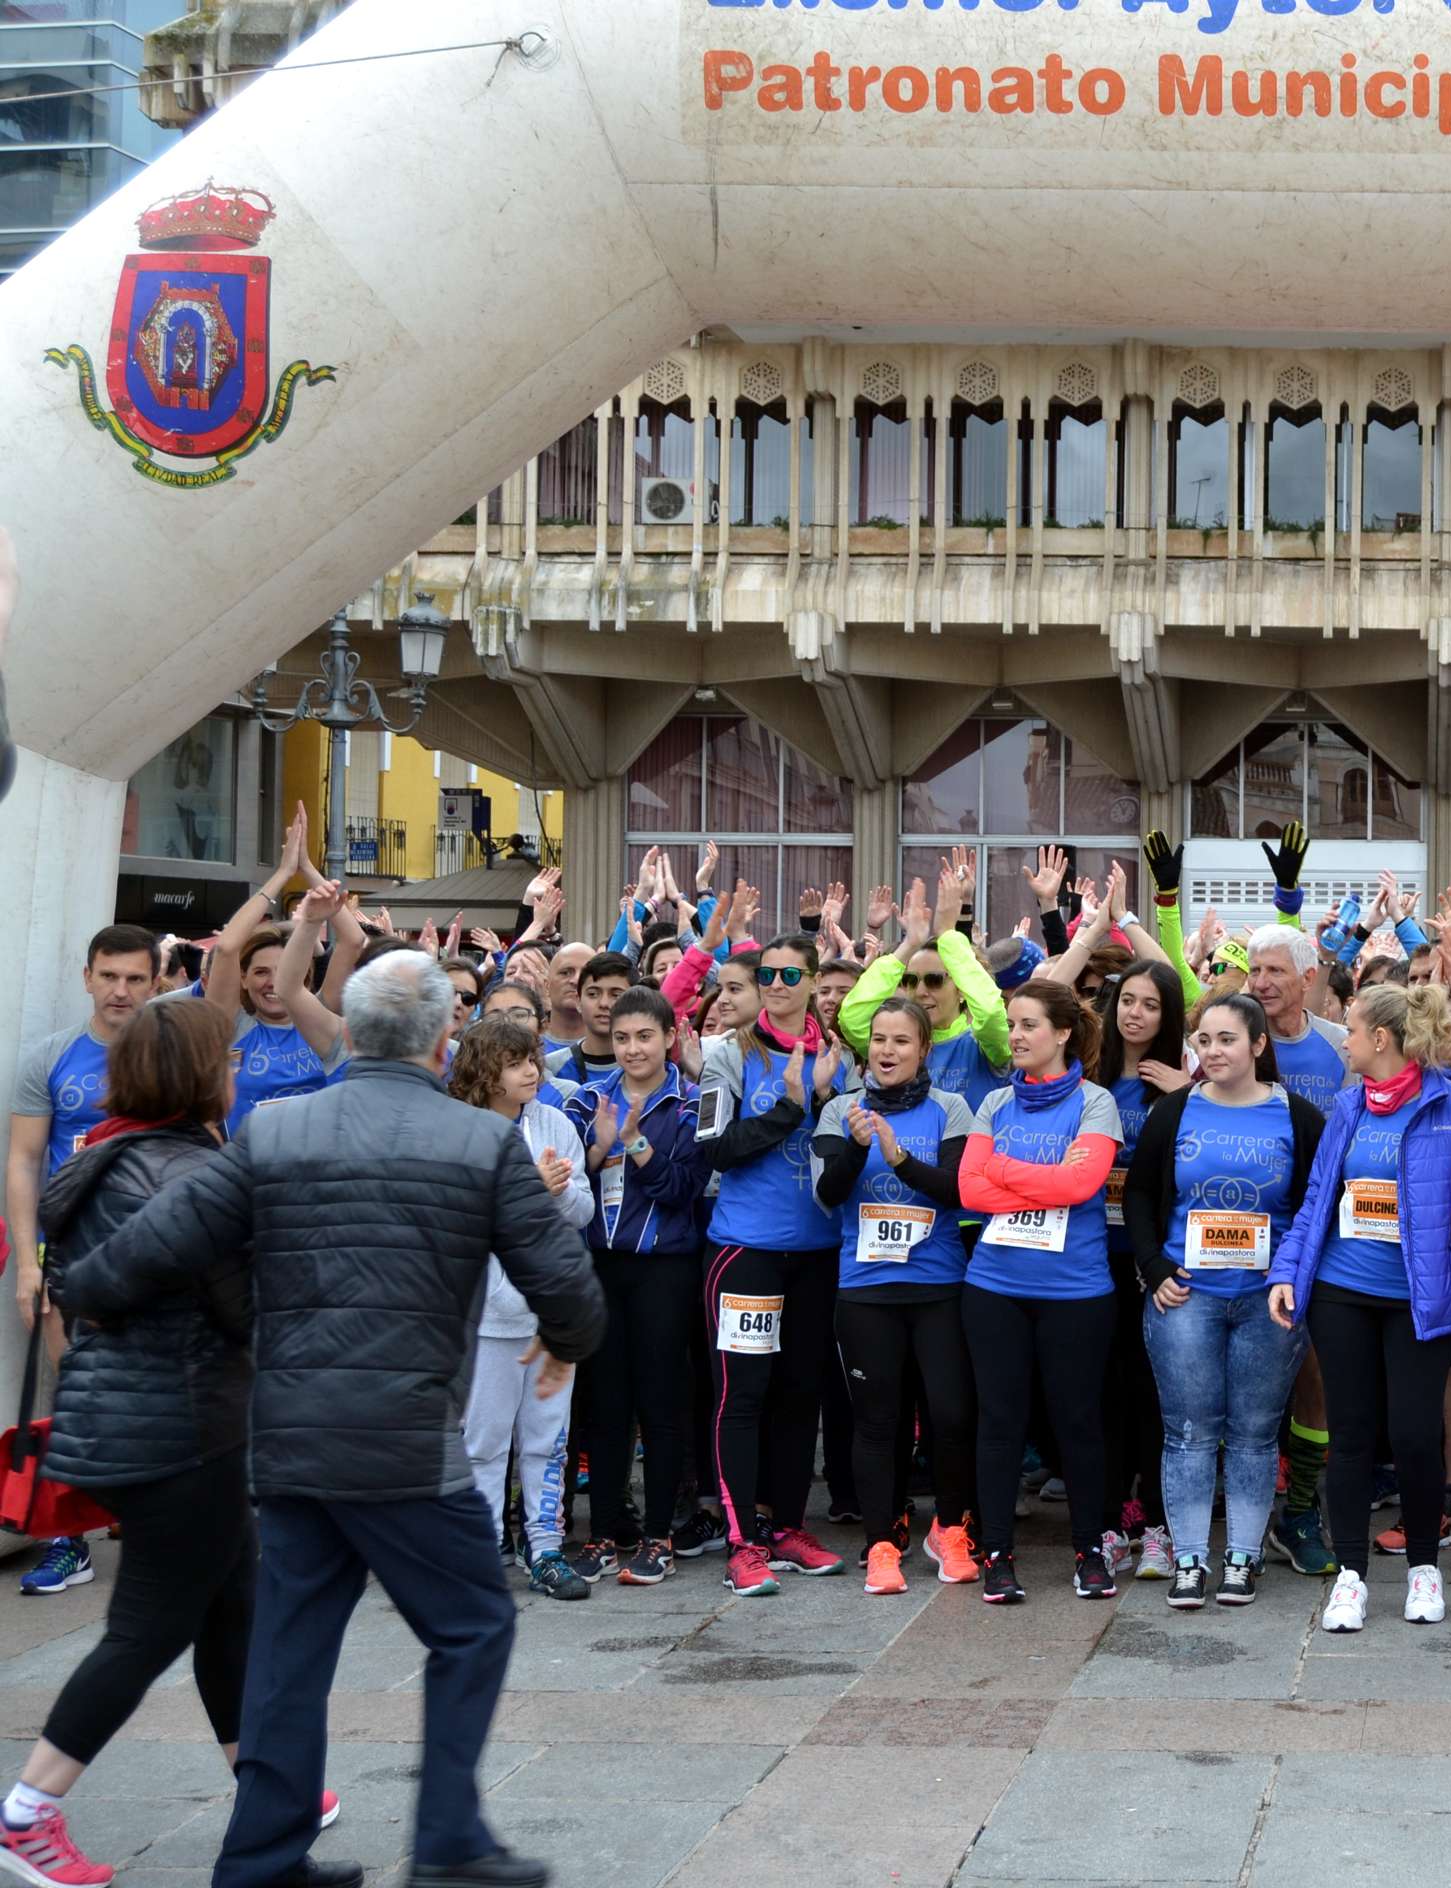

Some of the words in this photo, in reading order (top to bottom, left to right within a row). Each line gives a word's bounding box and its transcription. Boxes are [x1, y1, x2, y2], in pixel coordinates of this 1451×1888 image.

[703, 50, 1126, 115] Patronato
[1009, 1125, 1072, 1147] Carrera
[1201, 1129, 1275, 1150] Carrera
[1356, 1125, 1401, 1145] Carre
[1234, 1146, 1288, 1174] Mujer
[1007, 1208, 1047, 1228] 369
[1201, 1214, 1233, 1222] carrera
[878, 1220, 913, 1242] 961
[1205, 1228, 1250, 1241] DAMA
[1199, 1247, 1256, 1257] divinapastora
[739, 1312, 773, 1333] 648
